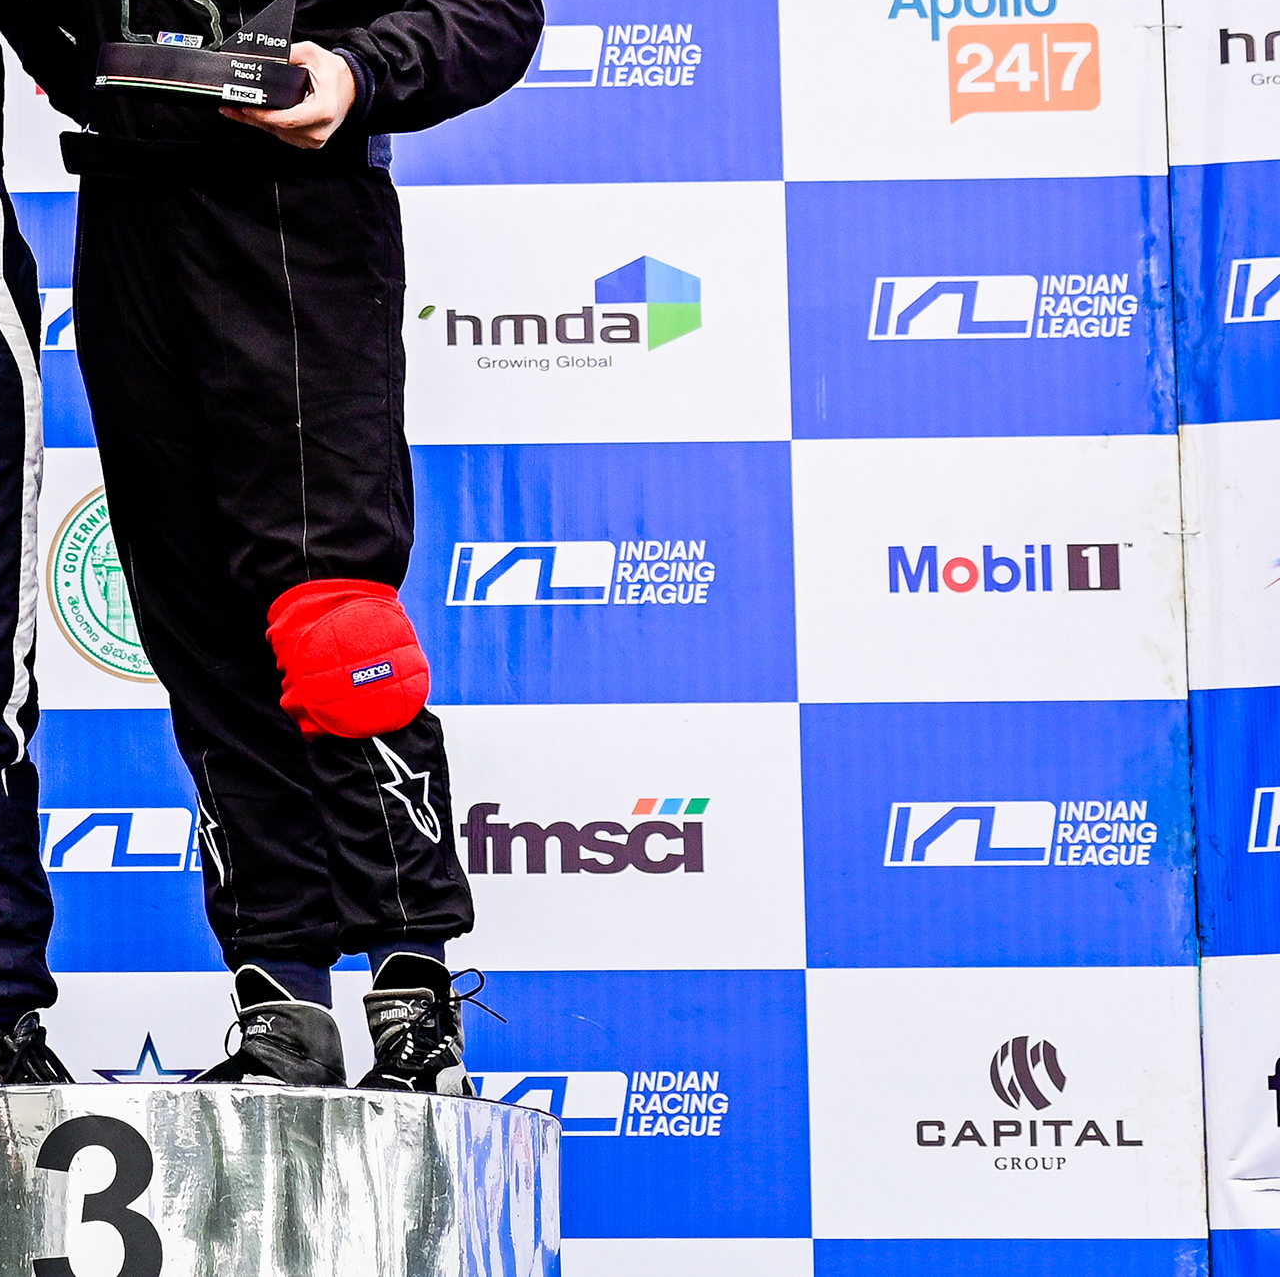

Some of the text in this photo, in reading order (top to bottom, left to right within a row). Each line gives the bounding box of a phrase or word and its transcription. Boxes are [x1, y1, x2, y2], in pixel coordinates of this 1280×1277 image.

[237, 31, 288, 48] 3rd Place
[606, 24, 692, 45] INDIAN
[230, 59, 263, 72] Round 4
[604, 44, 701, 66] RACING
[234, 69, 261, 81] Race 2
[601, 65, 695, 88] LEAGUE
[229, 87, 257, 99] fmsci
[1042, 274, 1128, 294] INDIAN
[1039, 294, 1137, 316] RACING
[446, 305, 641, 347] hmda
[1036, 315, 1131, 339] LEAGUE
[476, 354, 612, 372] Growing Global
[619, 540, 706, 561] INDIAN
[616, 560, 715, 583] RACING
[888, 544, 1053, 594] Mobil
[613, 582, 708, 605] LEAGUE
[1059, 801, 1147, 821] INDIAN
[460, 802, 704, 875] fmsci
[1057, 821, 1157, 844] RACING
[1053, 843, 1150, 867] LEAGUE
[380, 1007, 408, 1021] PUMA
[631, 1071, 719, 1092] INDIAN
[629, 1092, 729, 1114] RACING
[626, 1114, 722, 1137] LEAGUE
[915, 1119, 1143, 1148] CAPITAL
[994, 1156, 1068, 1171] GROUP
[33, 1114, 163, 1277] 3
